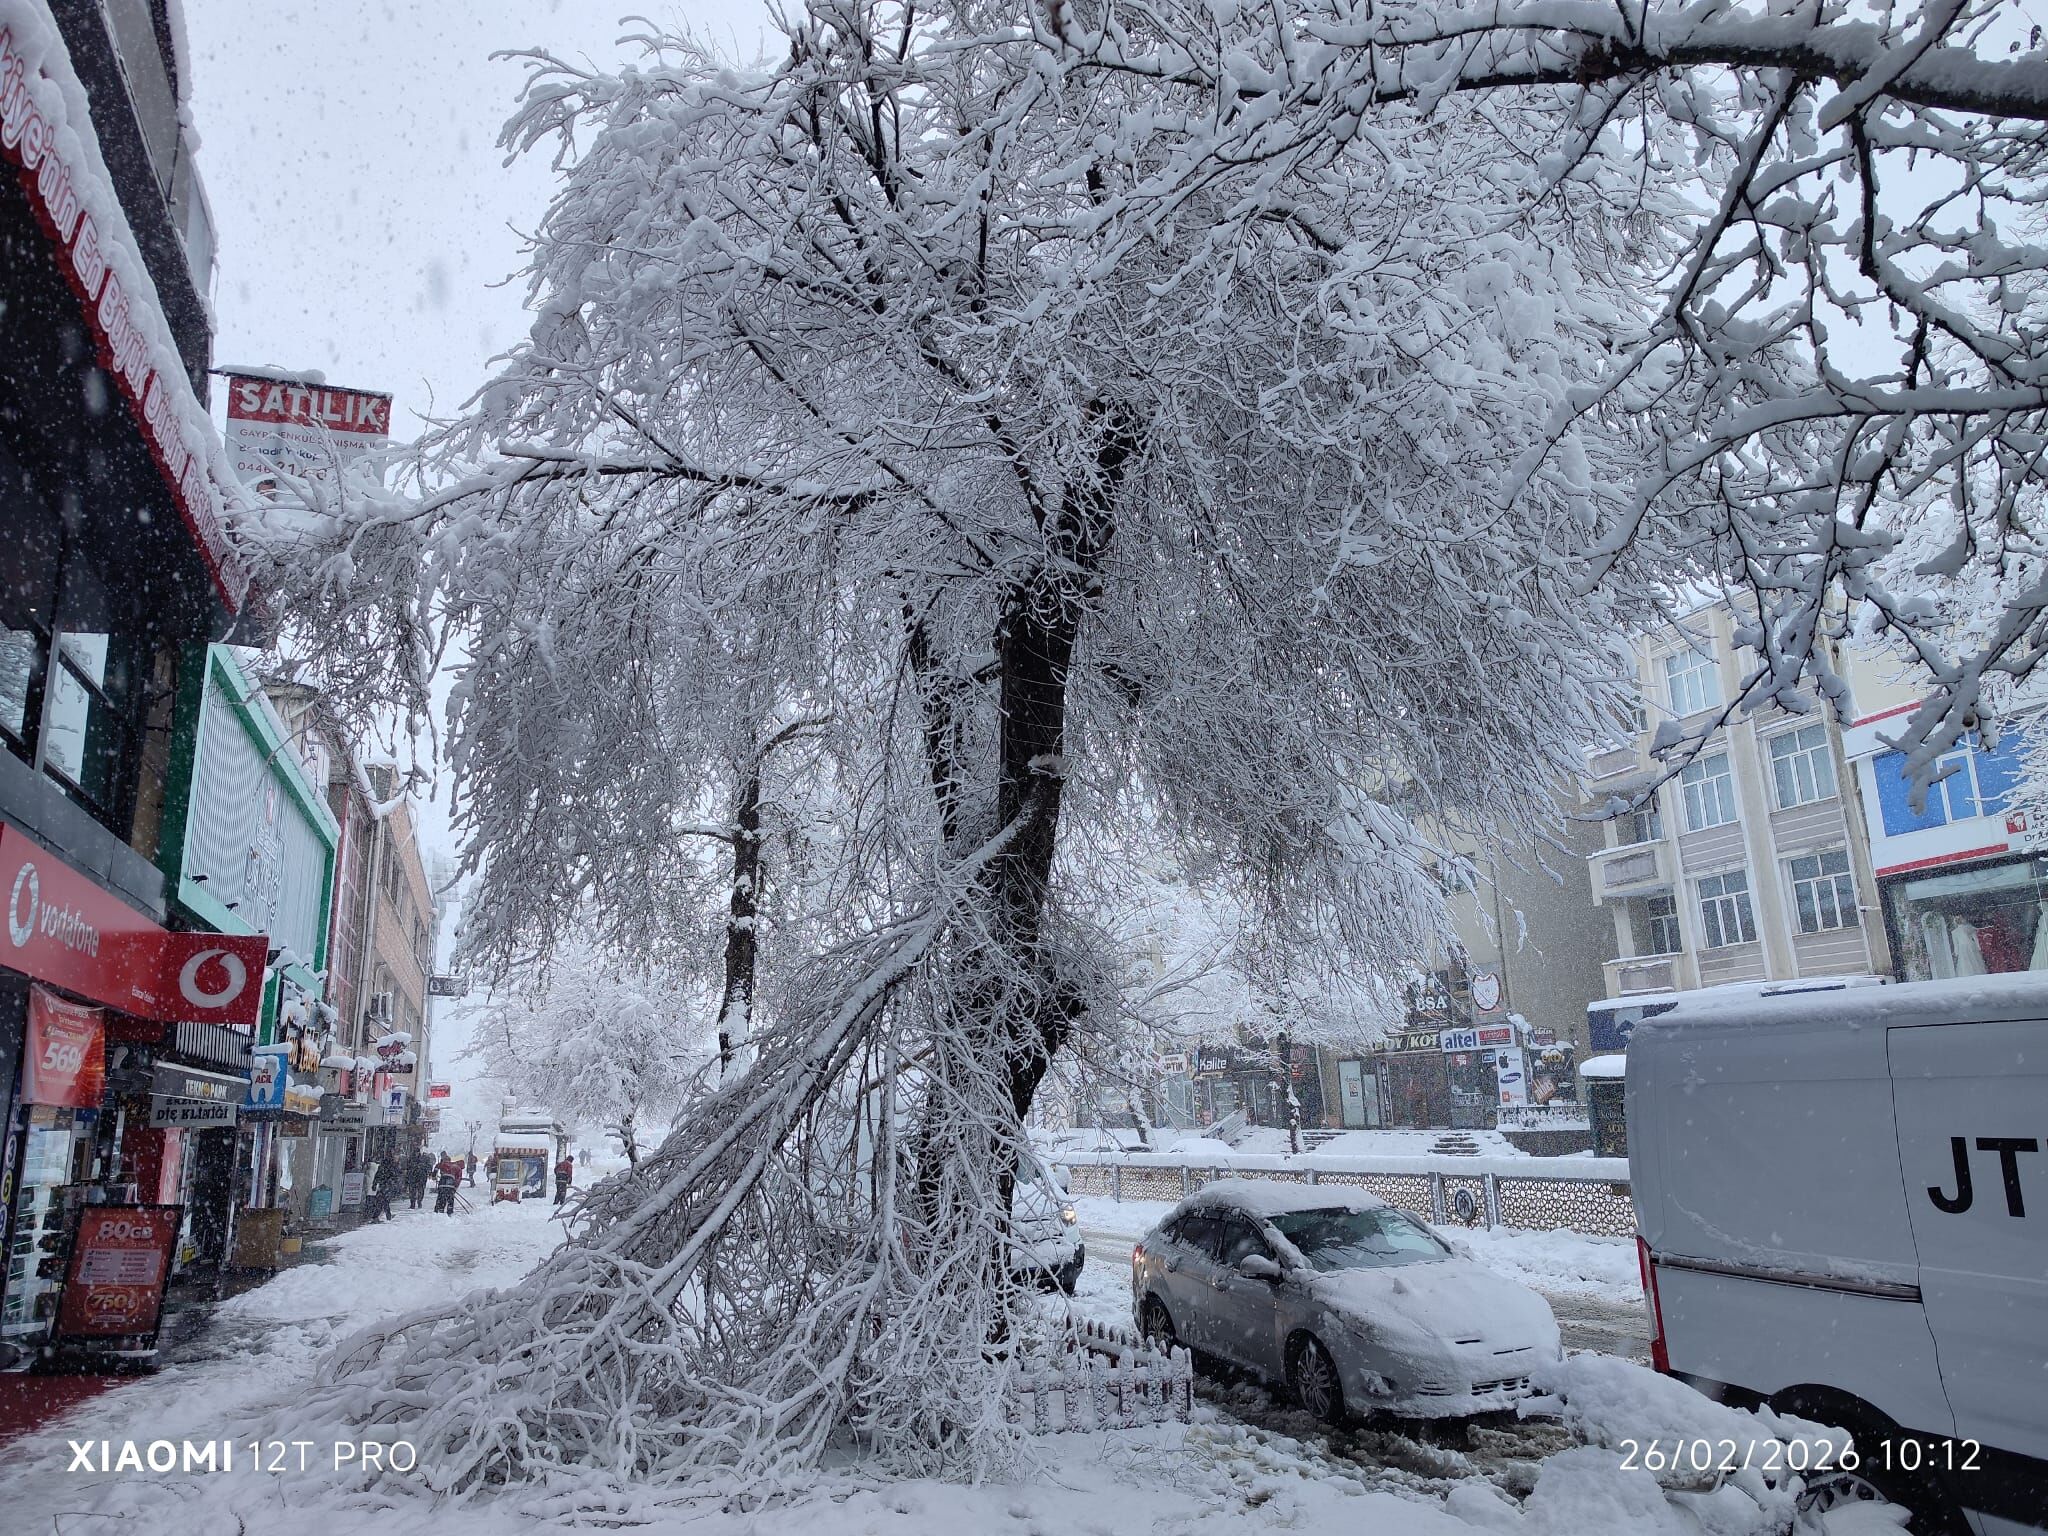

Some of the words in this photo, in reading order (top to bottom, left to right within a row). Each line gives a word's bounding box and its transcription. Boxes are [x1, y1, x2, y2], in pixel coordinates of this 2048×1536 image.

[72, 211, 105, 300] En
[238, 382, 381, 425] SATILIK
[40, 900, 100, 958] vodafone
[1199, 1056, 1227, 1070] Kalite
[1445, 1031, 1477, 1050] altel
[1927, 1136, 2048, 1218] JT
